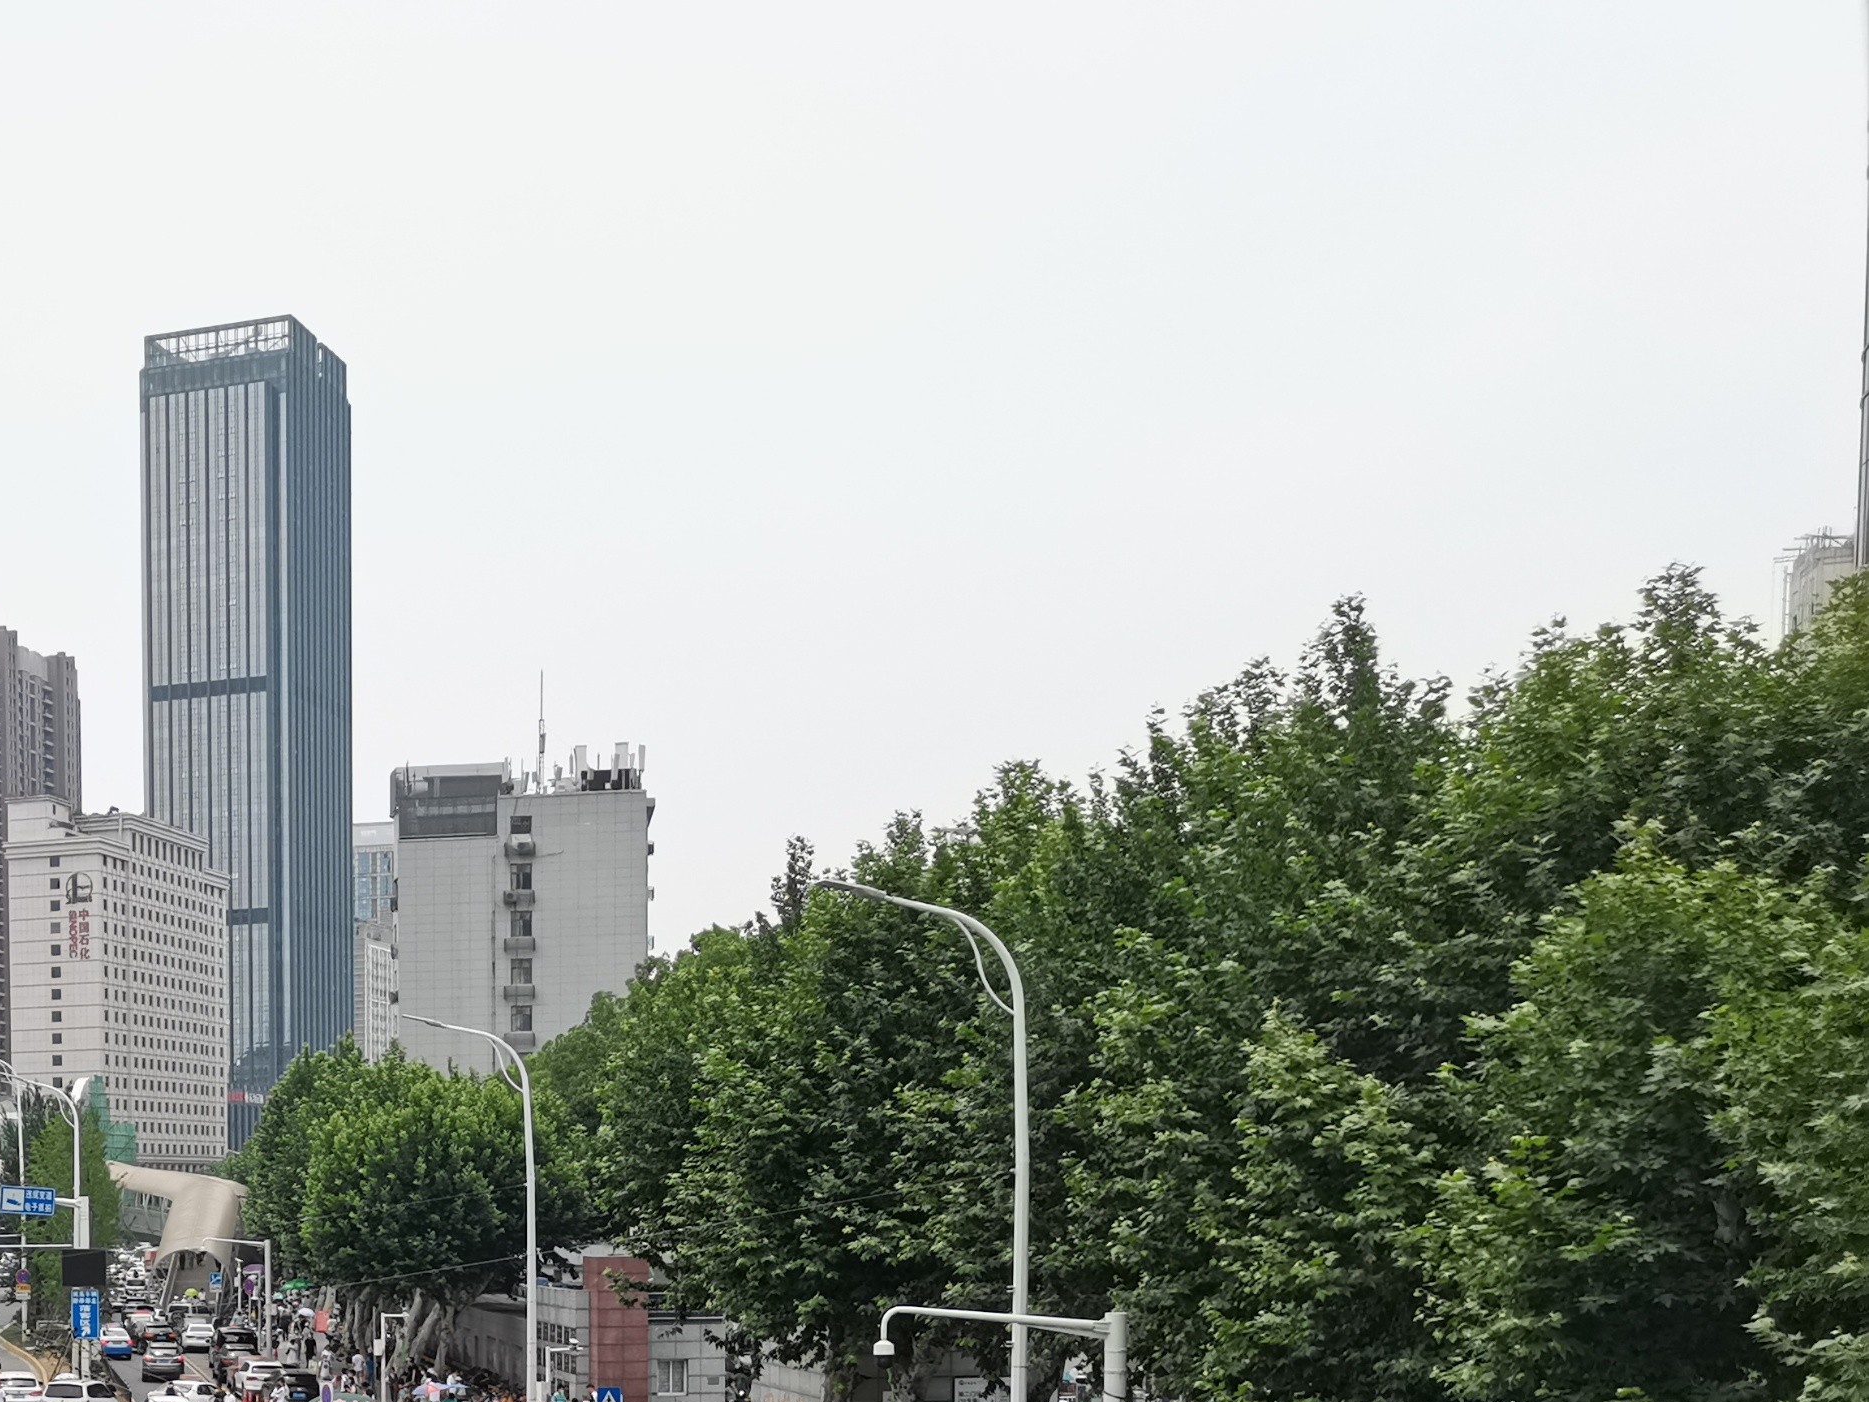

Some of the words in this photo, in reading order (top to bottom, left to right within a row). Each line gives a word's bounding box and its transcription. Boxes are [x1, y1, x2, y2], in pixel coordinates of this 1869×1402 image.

[69, 910, 78, 958] SINOPEC
[79, 908, 90, 960] 中国石化
